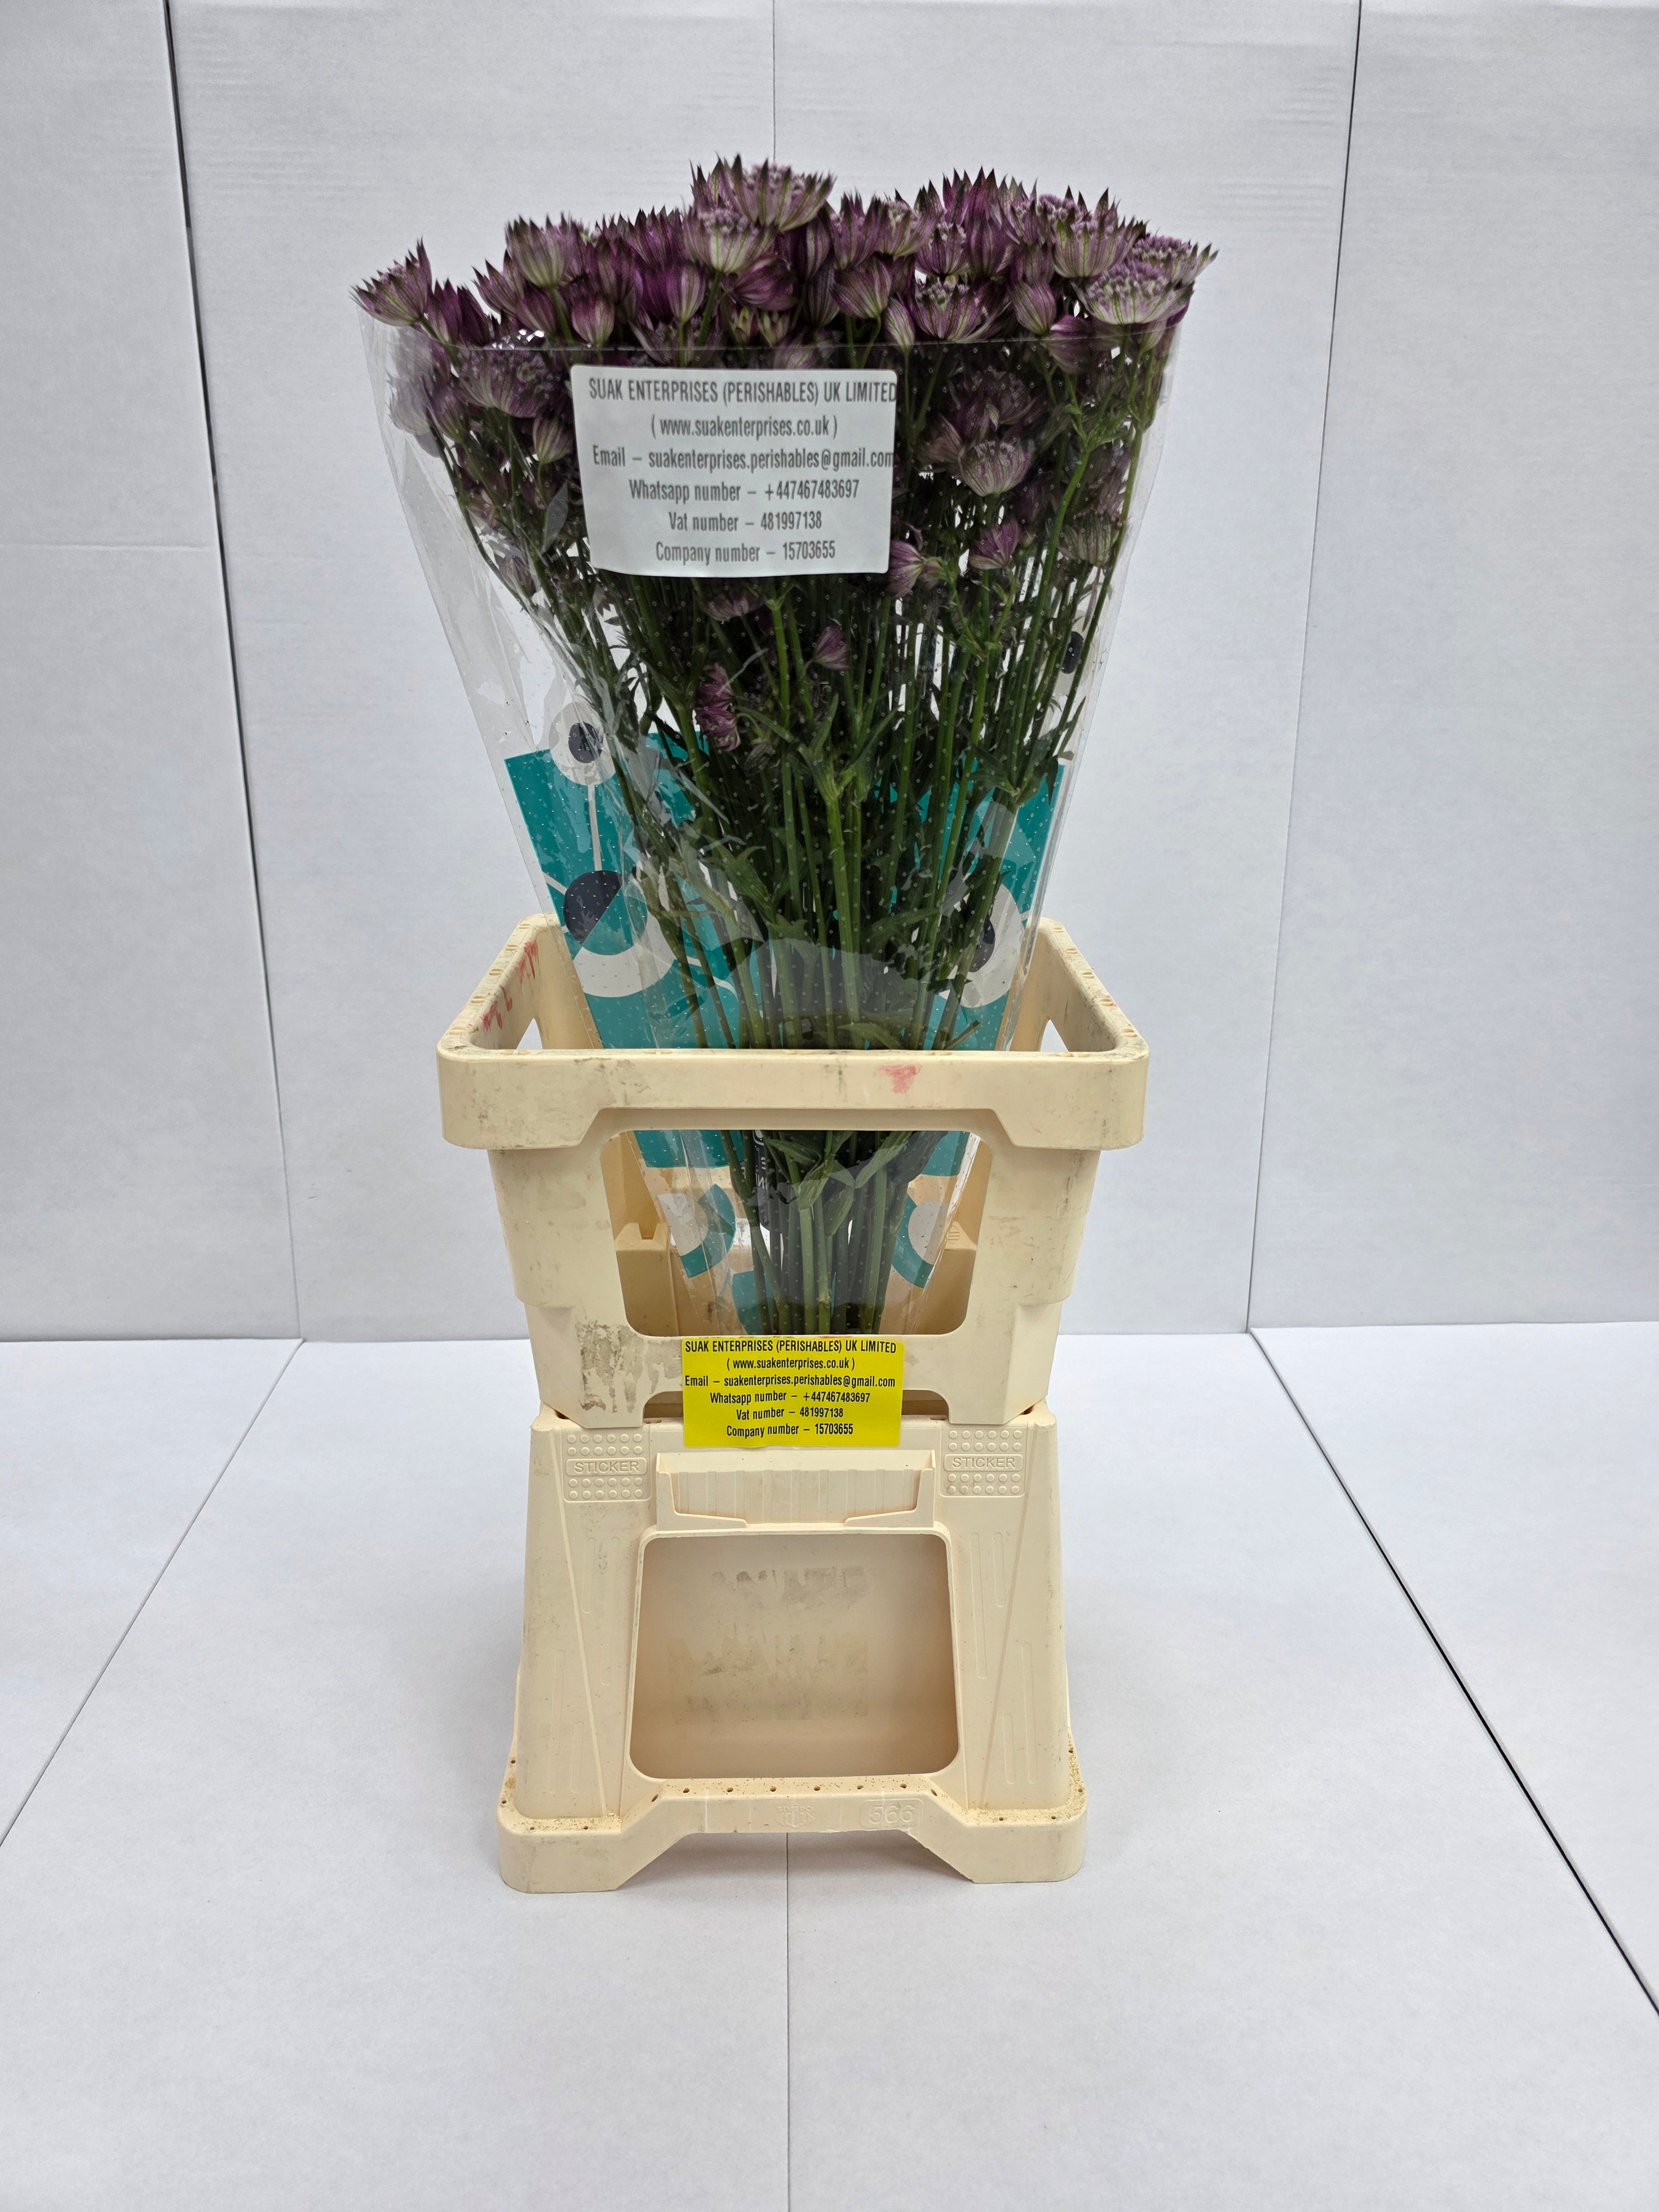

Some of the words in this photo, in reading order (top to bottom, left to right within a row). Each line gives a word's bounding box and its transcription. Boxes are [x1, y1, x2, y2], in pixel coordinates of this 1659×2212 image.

[589, 377, 623, 400] SUAK
[628, 379, 718, 403] ENTERPRISES
[723, 381, 819, 406] (PERISHABLES)
[824, 382, 841, 403] UK
[846, 382, 897, 403] LIMITED
[659, 414, 830, 441] www.suakenterprises.co.uk
[592, 445, 625, 467] Email
[628, 479, 690, 505] Whatsapp
[694, 481, 742, 502] number
[668, 511, 688, 531] Vat
[692, 513, 739, 532] number
[760, 510, 822, 531] 481997138
[655, 541, 711, 566] Company
[714, 542, 760, 562] number
[782, 540, 836, 561] 15703655
[685, 1340, 709, 1353] SUAK
[712, 1340, 773, 1352] ENTERPRISES
[776, 1340, 842, 1354] (PERISHABLES)
[846, 1340, 858, 1352] UK
[860, 1340, 896, 1354] LIMITED
[732, 1357, 849, 1370] www.suakenterprises.co.uk
[685, 1375, 708, 1386] Email
[724, 1374, 895, 1389] suakenterprises.perishables@gmail.com
[709, 1392, 752, 1406] Whatsapp
[754, 1390, 787, 1402] number
[736, 1409, 750, 1421] Vat
[753, 1407, 785, 1420] number
[799, 1406, 843, 1418] 481997138
[727, 1425, 765, 1439] Company
[767, 1423, 800, 1435] number
[815, 1423, 853, 1435] 15703655
[574, 1460, 640, 1474] STICKER
[952, 1456, 1016, 1469] STICKER
[868, 1804, 915, 1824] 566
